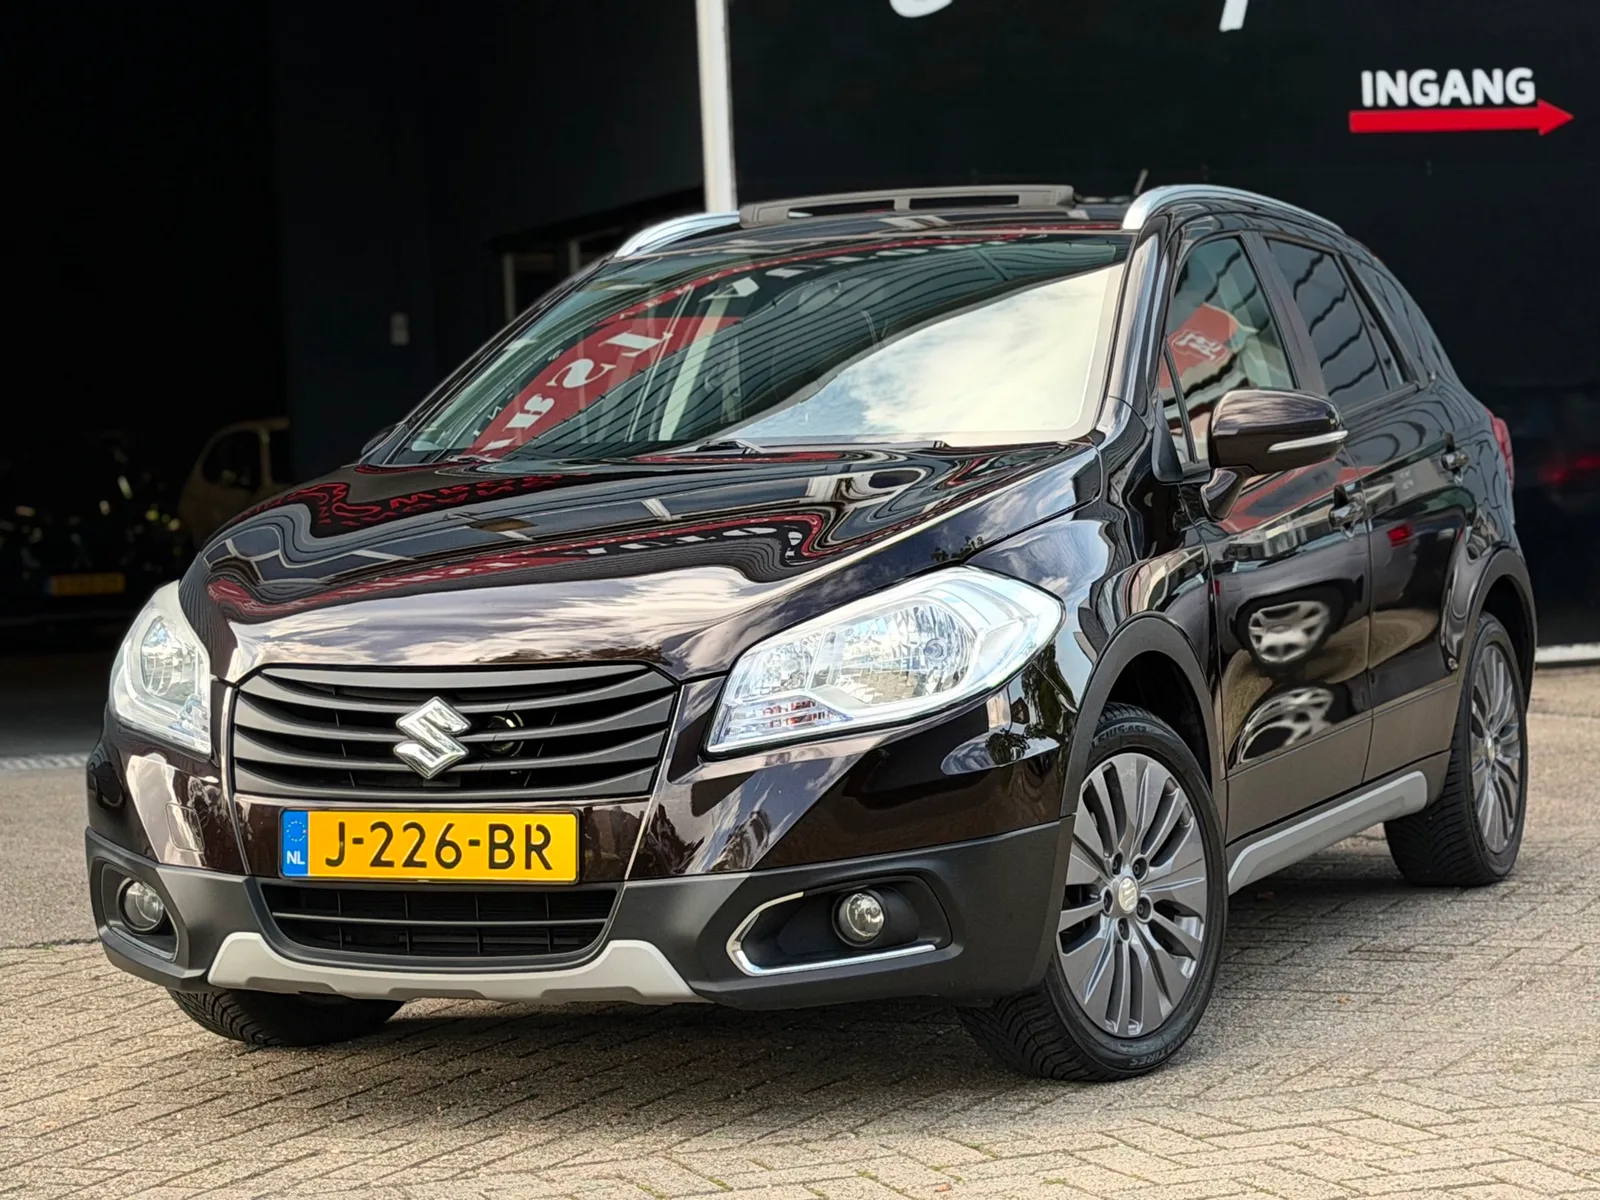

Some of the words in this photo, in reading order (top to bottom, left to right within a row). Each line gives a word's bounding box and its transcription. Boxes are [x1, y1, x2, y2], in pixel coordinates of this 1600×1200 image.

[1361, 67, 1536, 107] INGANG
[286, 850, 306, 865] NL
[325, 821, 554, 871] J-226-BR
